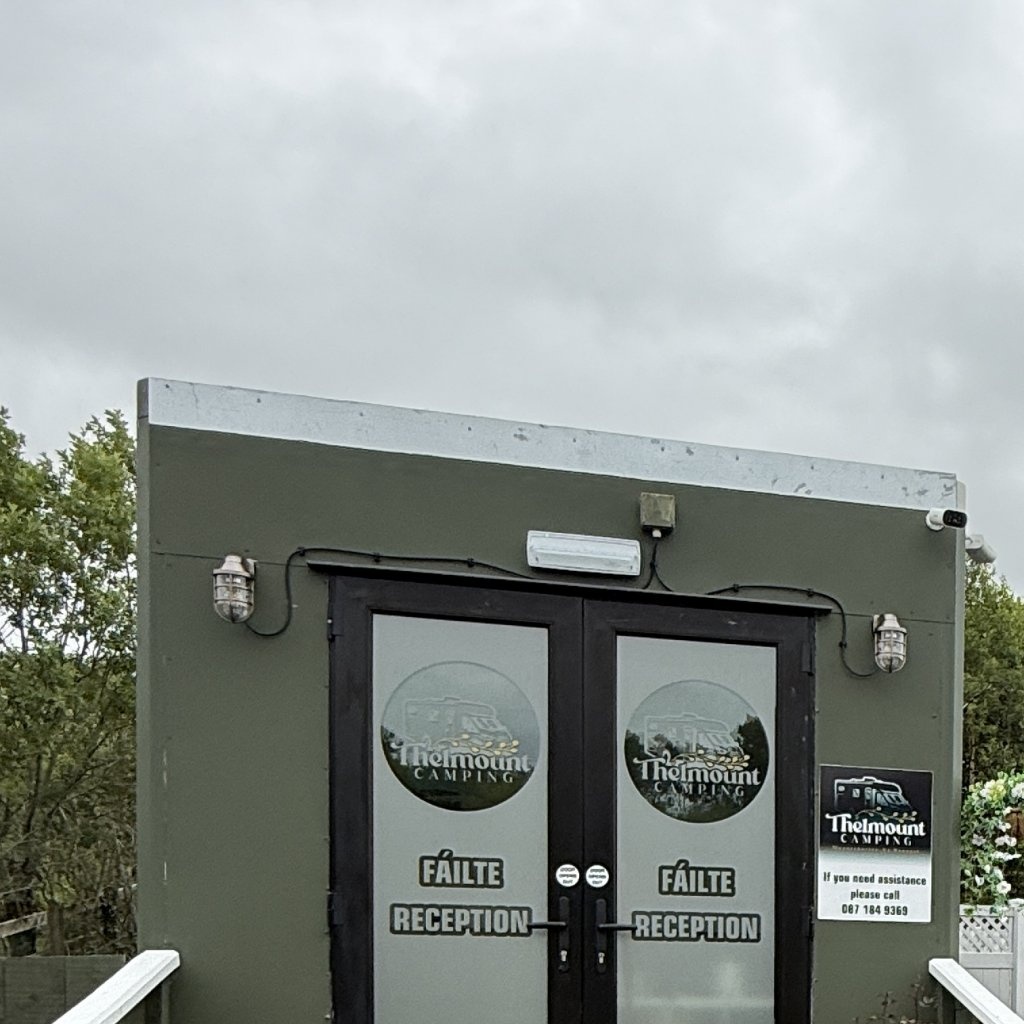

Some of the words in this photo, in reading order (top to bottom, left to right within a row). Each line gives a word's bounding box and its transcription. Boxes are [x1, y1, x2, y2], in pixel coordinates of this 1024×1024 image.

[390, 740, 533, 773] Thelmount
[414, 767, 514, 784] CAMPING
[633, 753, 761, 786] Thelmount
[654, 781, 745, 797] CAMPING
[825, 813, 926, 837] Thelmount
[840, 833, 912, 847] CAMPING
[422, 850, 501, 886] FÁILTE
[661, 862, 733, 894] FÁILTE
[823, 871, 832, 882] If
[833, 874, 850, 885] you
[852, 874, 875, 884] need
[878, 874, 927, 886] assistance
[850, 889, 881, 901] please
[883, 890, 900, 901] call
[393, 906, 529, 934] RECEPTION
[841, 904, 859, 915] 087
[863, 905, 881, 916] 184
[884, 905, 908, 917] 9369
[635, 914, 758, 940] RECEPTION
